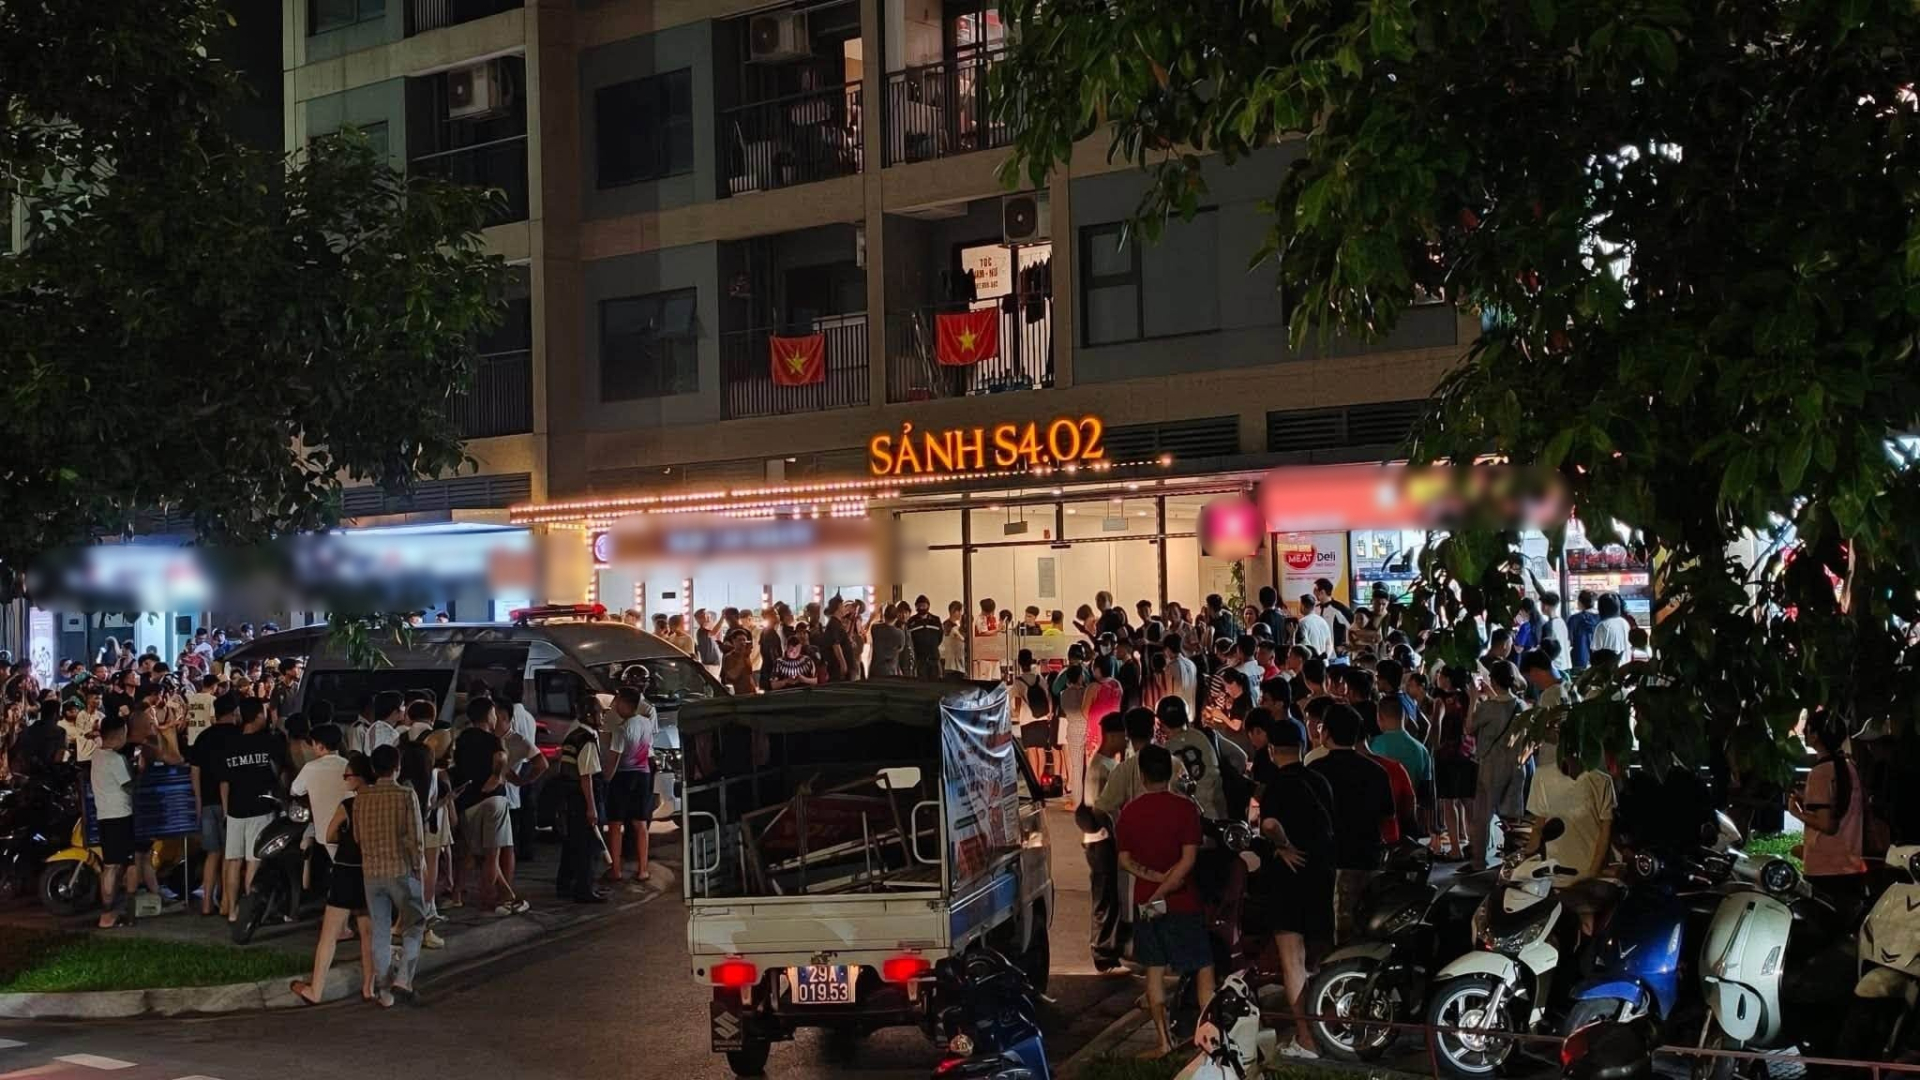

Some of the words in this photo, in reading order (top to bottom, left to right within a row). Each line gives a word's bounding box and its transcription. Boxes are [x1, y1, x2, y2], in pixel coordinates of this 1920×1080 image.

[870, 422, 984, 476] SẢNH
[1288, 553, 1313, 564] MEAT
[1316, 551, 1336, 562] Deli
[809, 966, 837, 983] 29A
[799, 983, 848, 1001] 019.53
